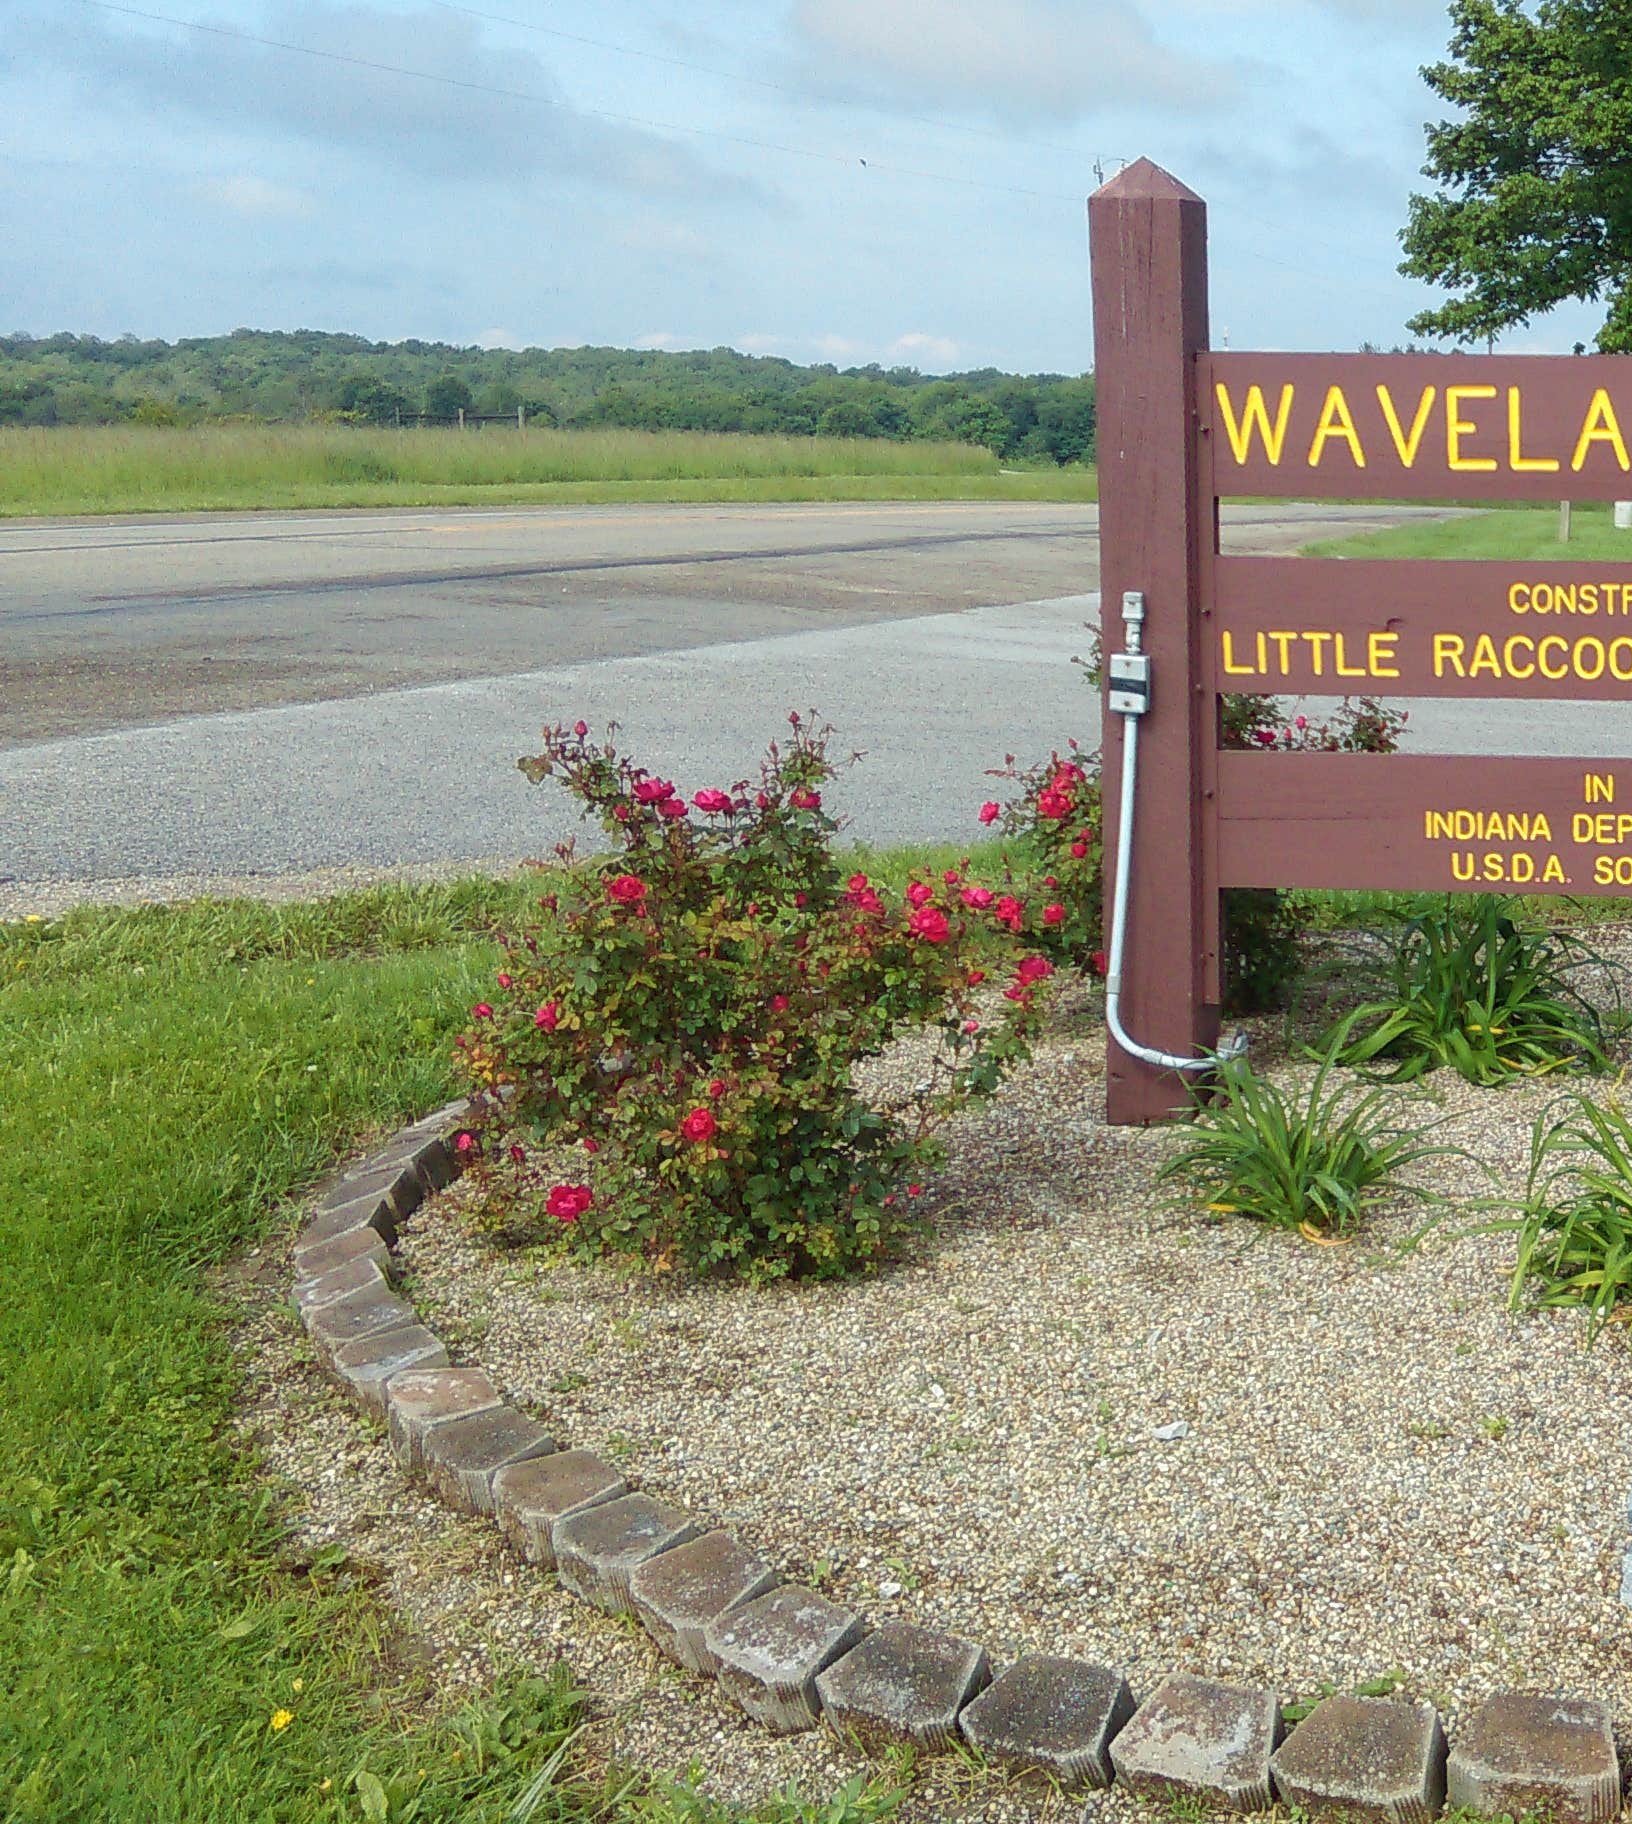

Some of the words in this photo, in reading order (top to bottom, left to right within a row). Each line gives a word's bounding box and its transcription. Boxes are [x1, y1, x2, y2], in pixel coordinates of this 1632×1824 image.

[1221, 629, 1402, 679] LITTLE
[1583, 772, 1616, 805] IN
[1423, 808, 1554, 843] INDIANA
[1449, 850, 1574, 885] U.S.D.A.
